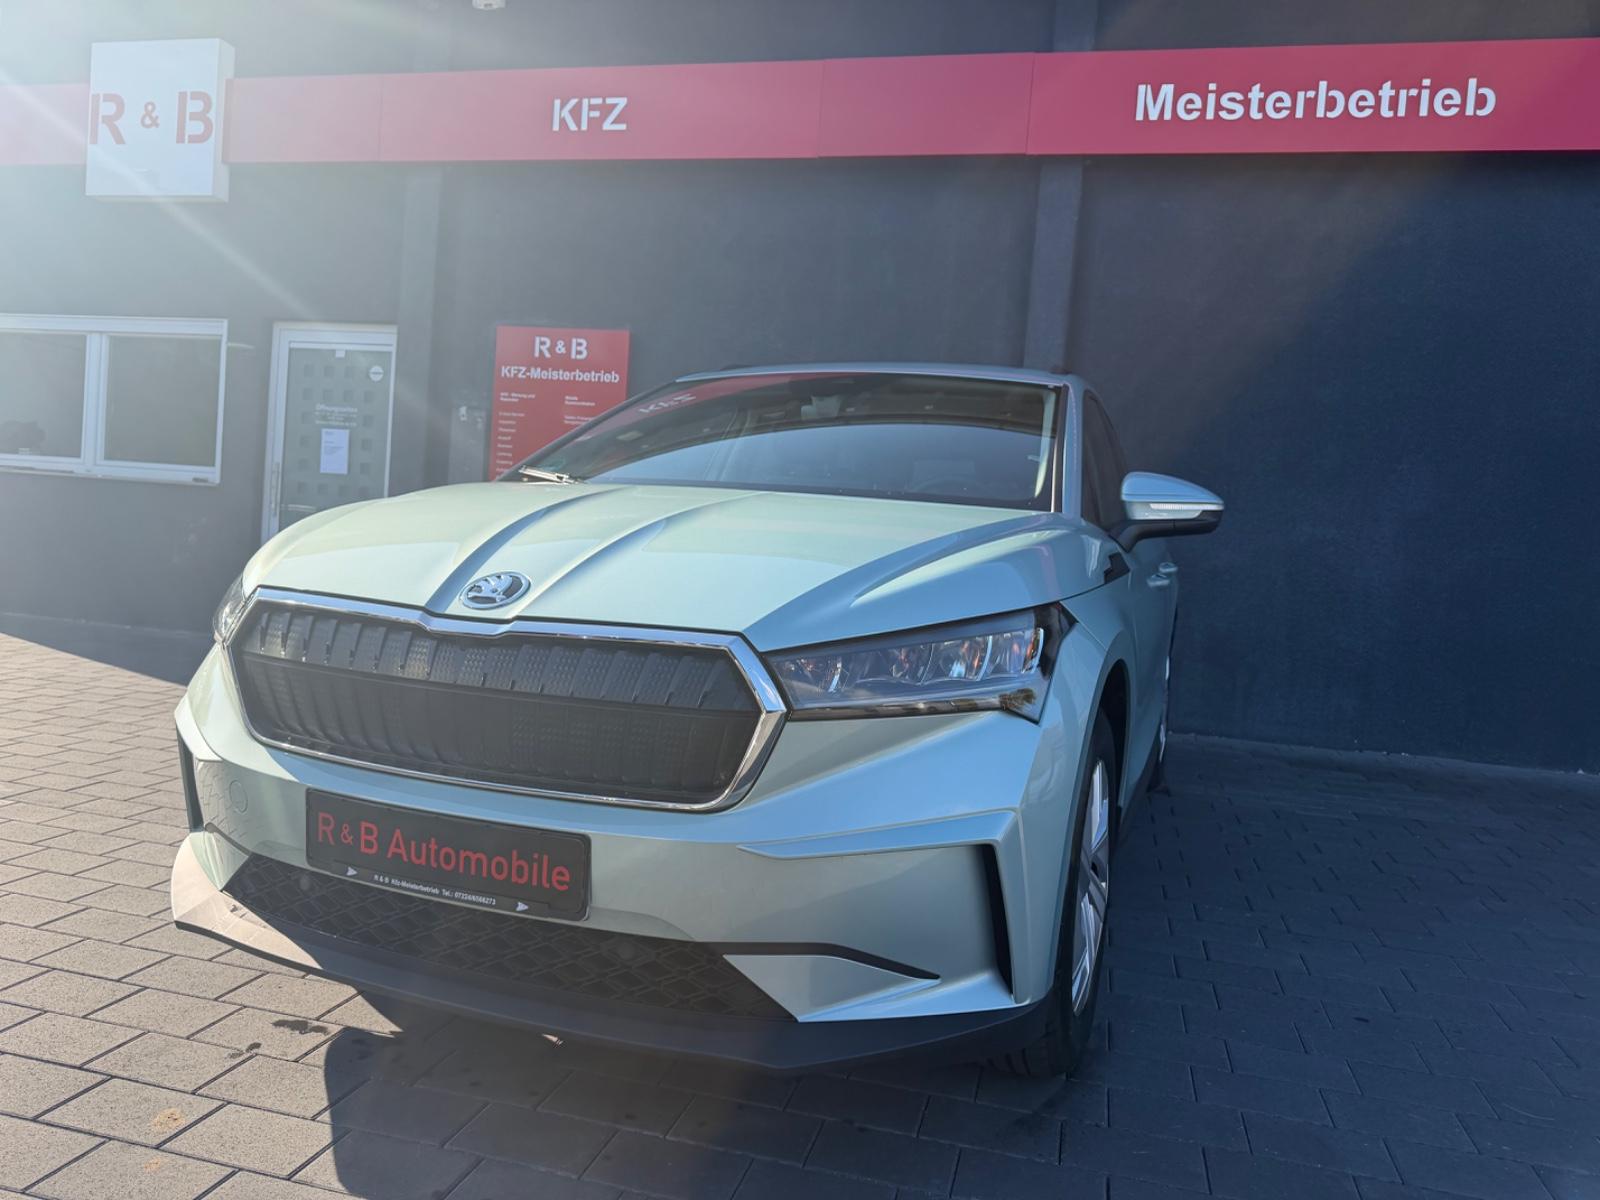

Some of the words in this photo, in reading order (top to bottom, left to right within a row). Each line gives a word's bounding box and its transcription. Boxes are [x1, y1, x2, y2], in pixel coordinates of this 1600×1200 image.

[89, 93, 126, 145] R
[140, 101, 161, 129] &
[175, 90, 214, 145] B
[551, 96, 628, 132] KFZ
[1135, 77, 1498, 122] Meisterbetrieb
[534, 336, 551, 358] R
[555, 340, 566, 354] &
[571, 337, 588, 360] B
[500, 366, 620, 384] KFZ-Meisterbetrieb
[317, 811, 335, 846] R
[340, 823, 353, 845] &
[360, 820, 379, 854] B
[386, 828, 570, 891] Automobile
